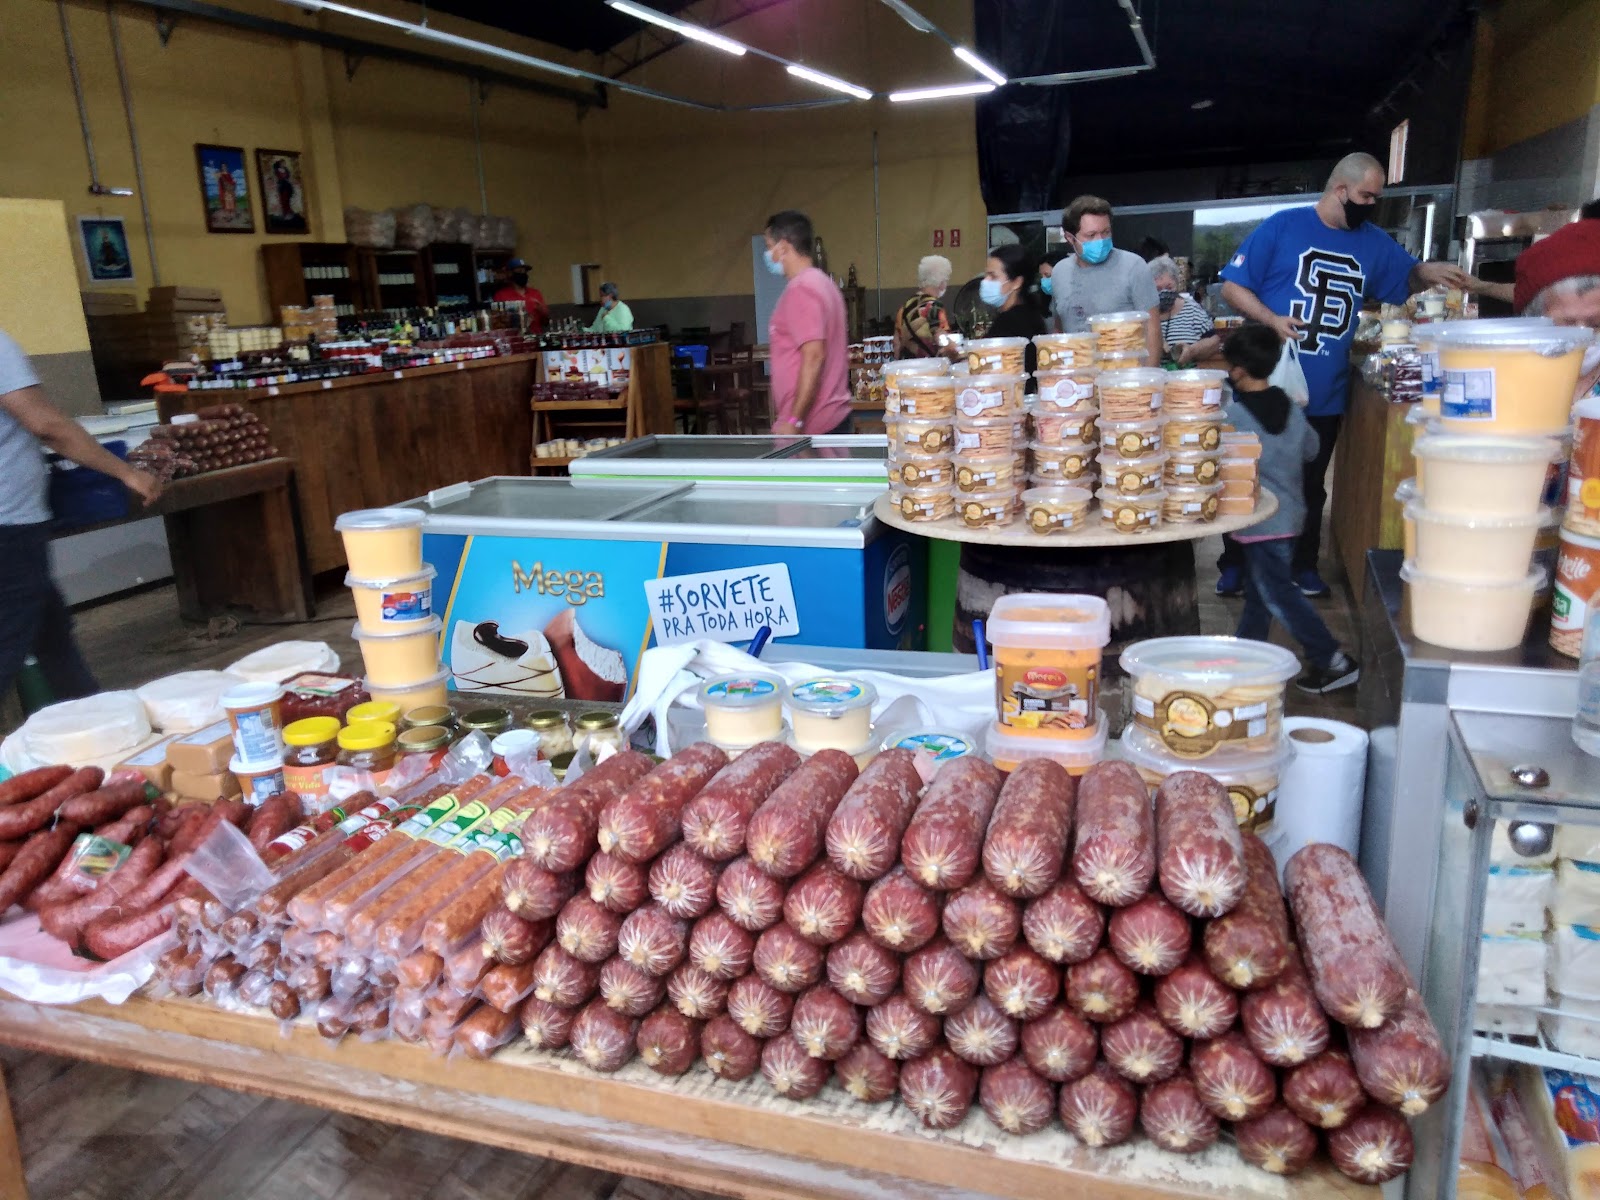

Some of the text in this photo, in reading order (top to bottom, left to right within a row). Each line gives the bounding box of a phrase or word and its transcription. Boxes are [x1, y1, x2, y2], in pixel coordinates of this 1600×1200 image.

[511, 559, 605, 606] Mega
[657, 573, 775, 616] #SORVETE
[662, 604, 790, 639] PRA TODA HORA
